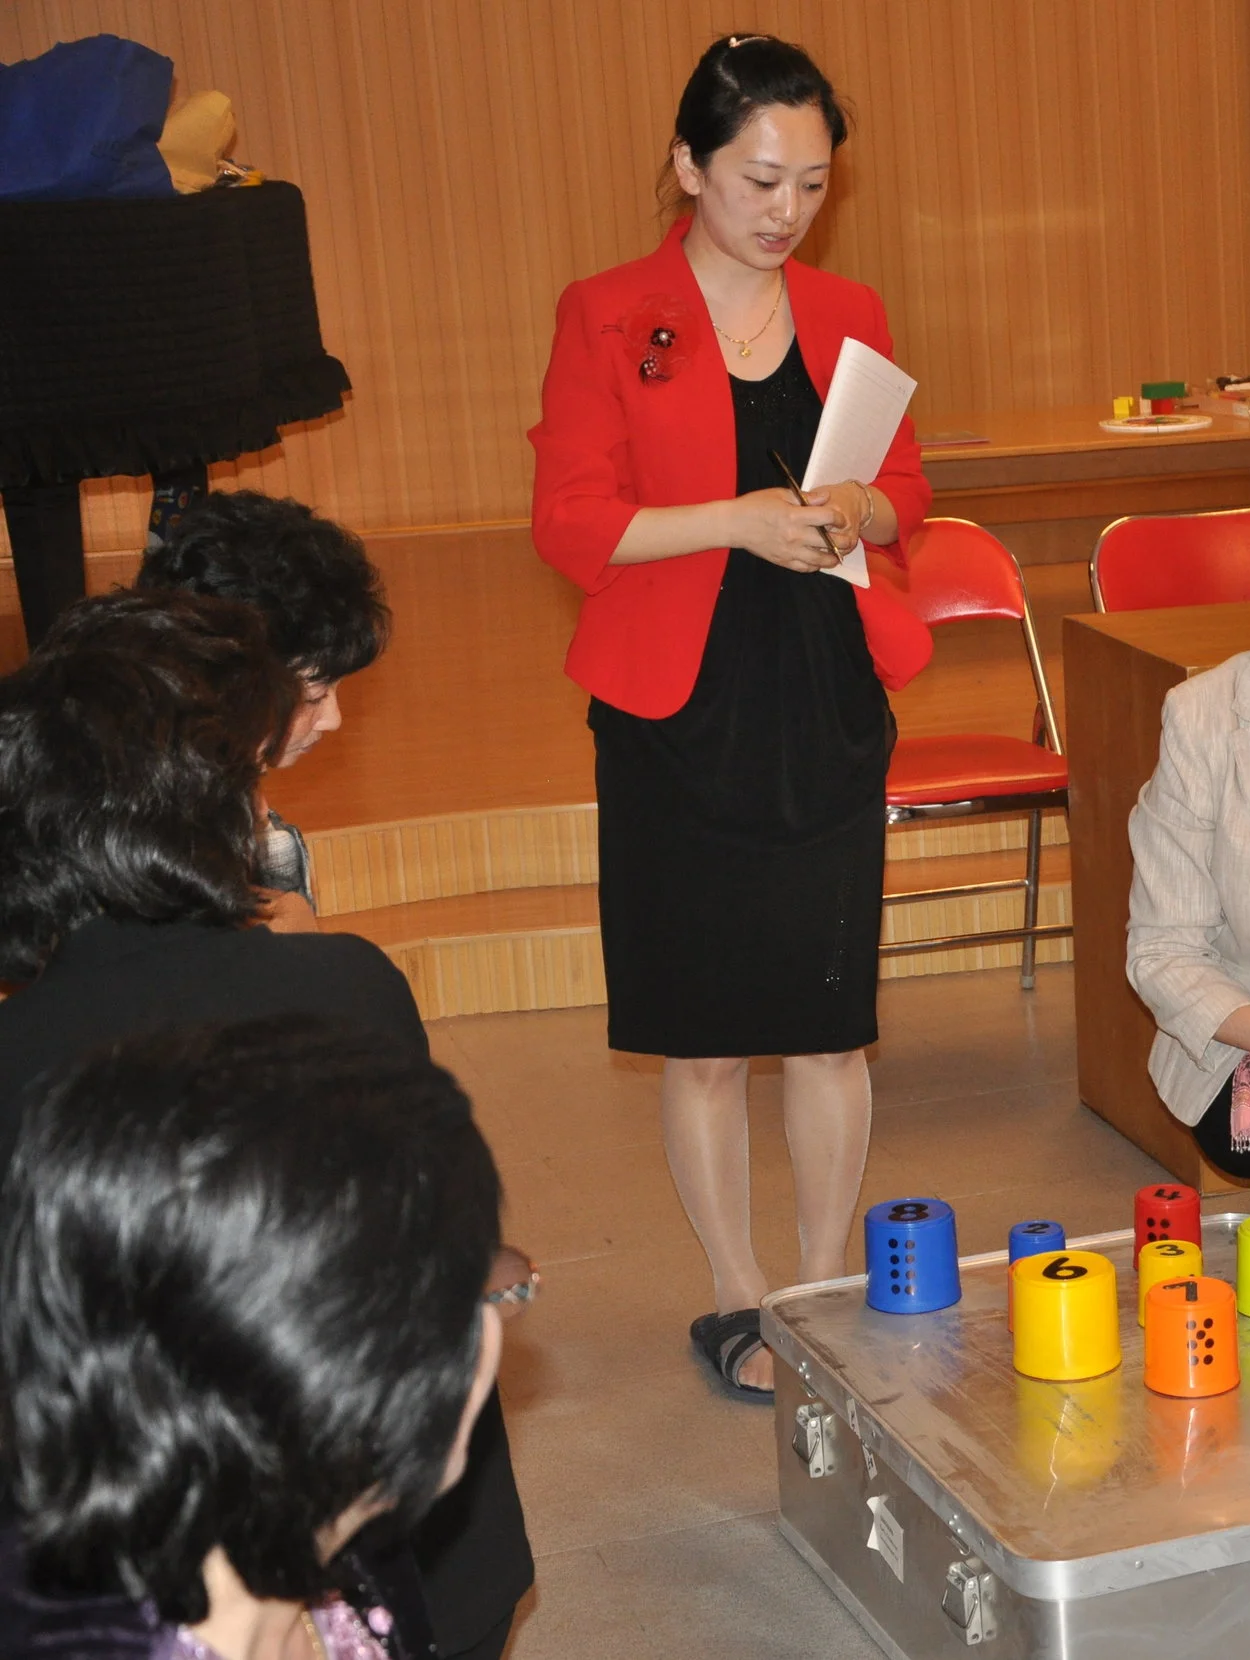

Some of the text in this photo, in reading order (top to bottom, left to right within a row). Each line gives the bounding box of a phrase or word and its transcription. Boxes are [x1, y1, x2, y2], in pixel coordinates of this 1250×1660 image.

[887, 1202, 930, 1222] 8
[1021, 1222, 1050, 1235] 2
[1154, 1243, 1186, 1257] 3
